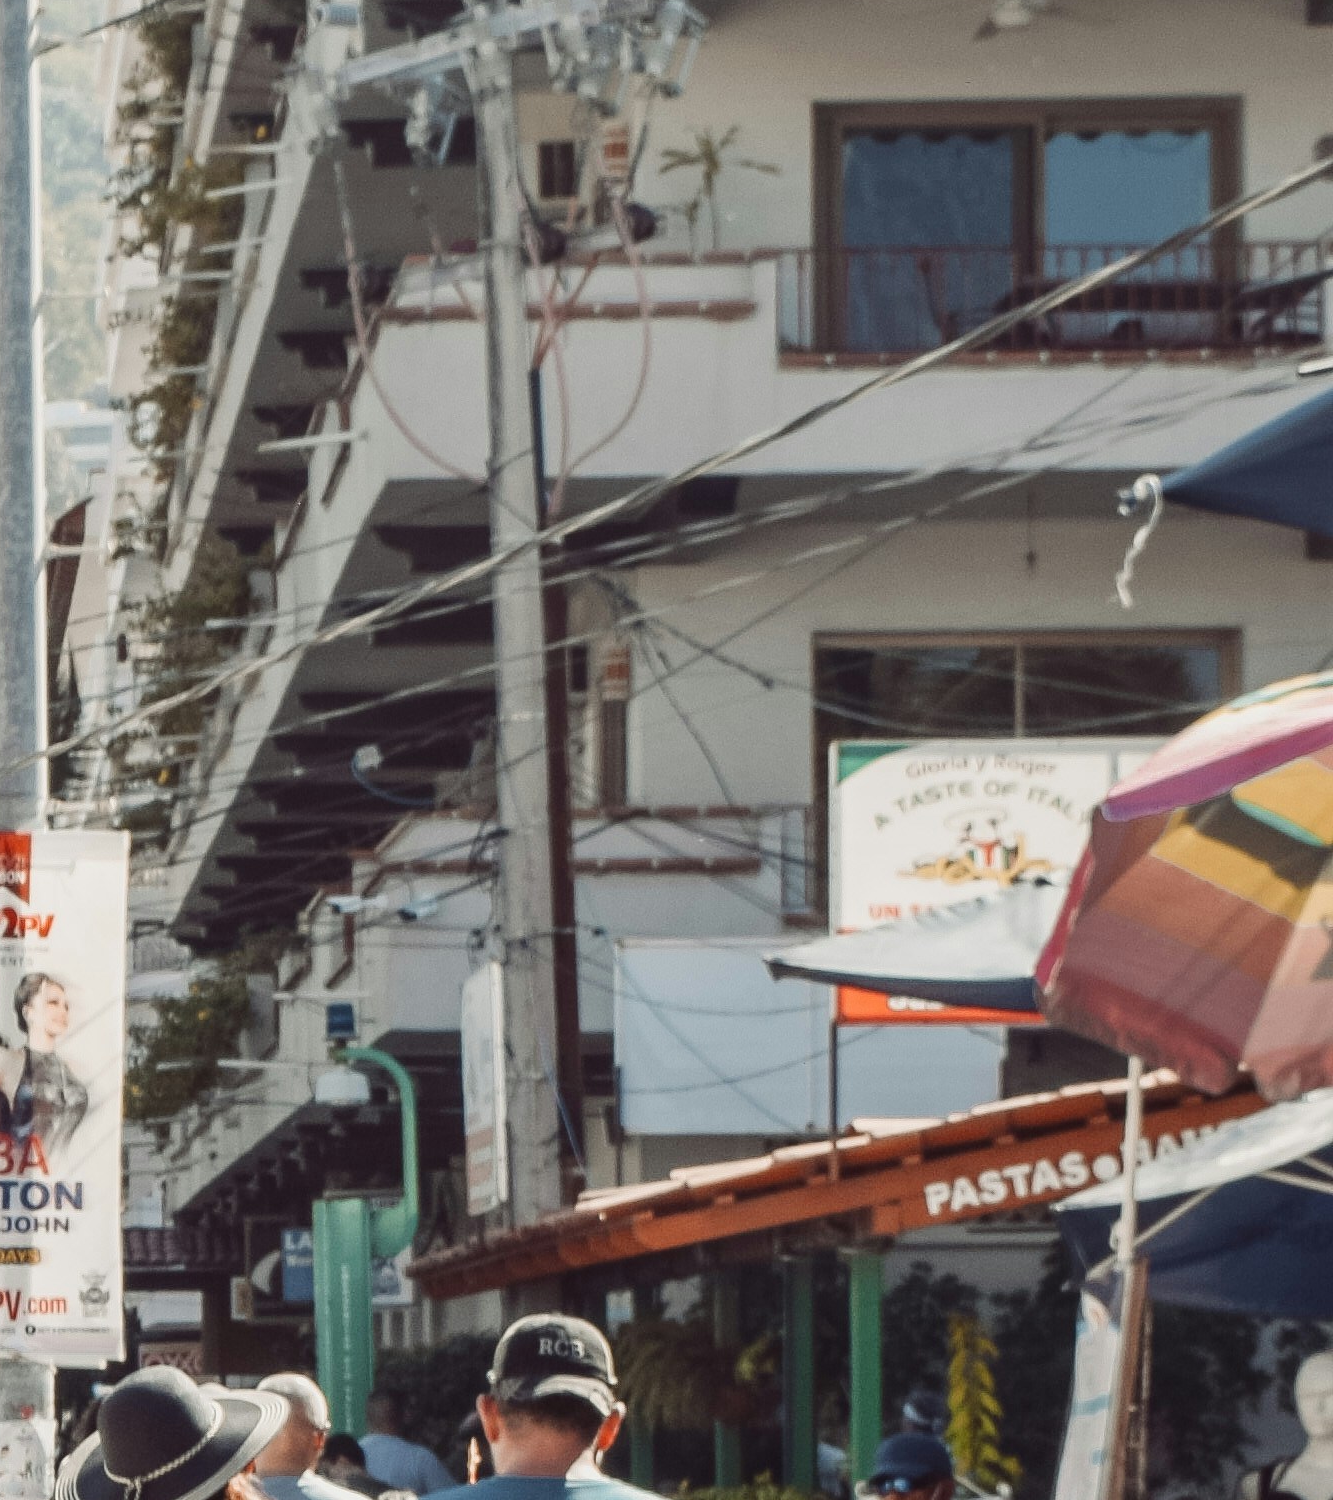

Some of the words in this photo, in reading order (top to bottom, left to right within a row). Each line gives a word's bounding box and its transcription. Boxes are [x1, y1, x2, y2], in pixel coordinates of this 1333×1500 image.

[896, 780, 974, 814] TASTE
[984, 779, 1017, 796] OF
[924, 1151, 1090, 1216] PASTAS
[0, 1216, 70, 1233] JOHN
